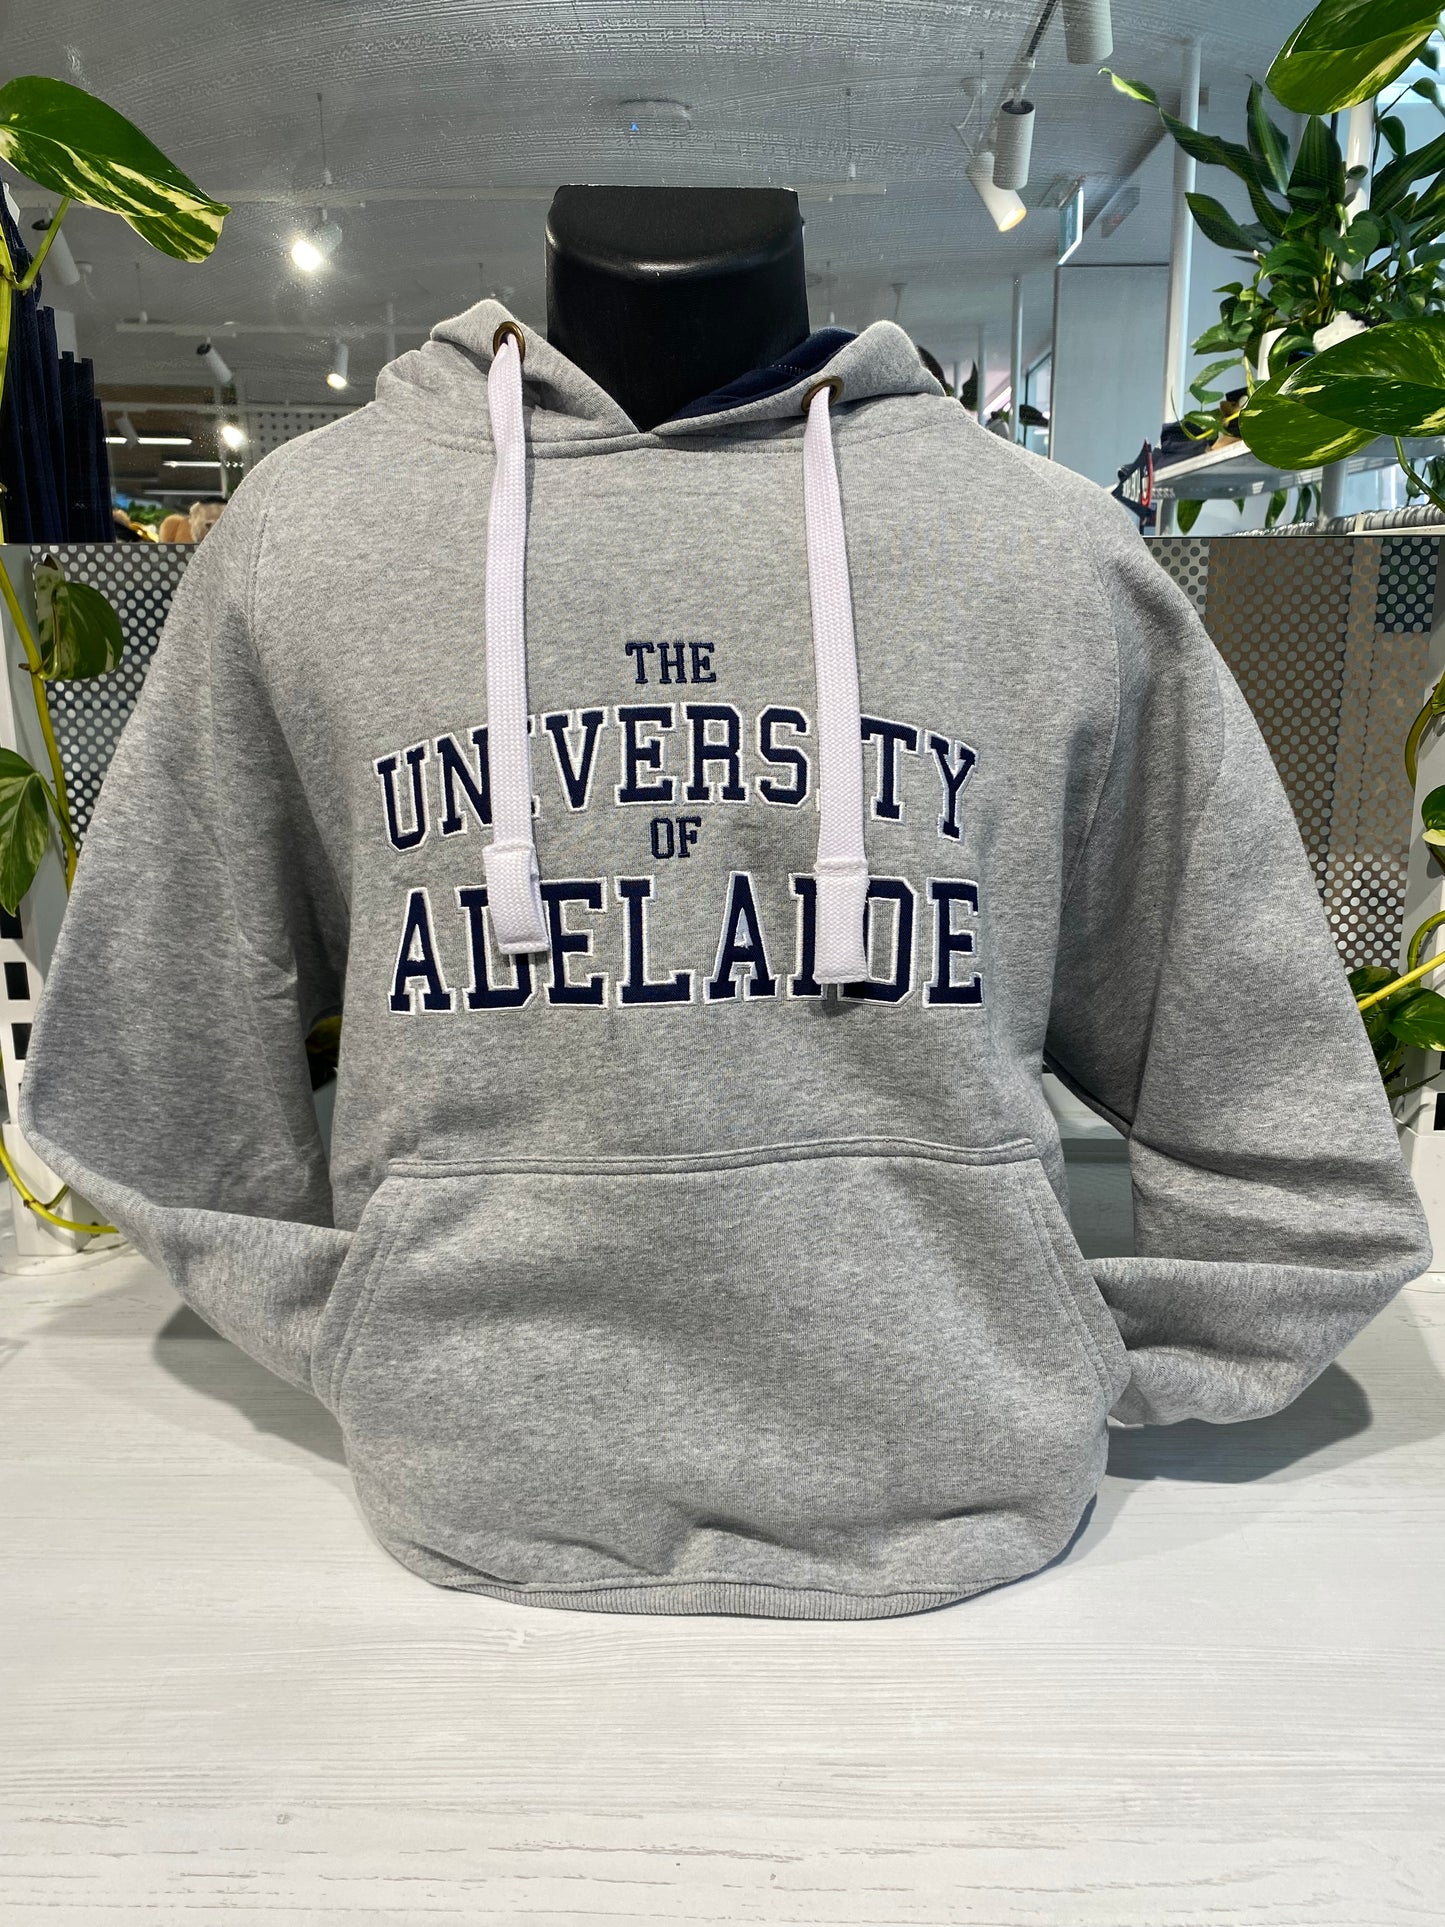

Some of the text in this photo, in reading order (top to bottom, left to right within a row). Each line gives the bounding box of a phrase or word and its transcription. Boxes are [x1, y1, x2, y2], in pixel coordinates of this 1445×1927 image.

[625, 641, 717, 684] THE
[373, 702, 979, 852] UNVERSTY
[650, 815, 701, 859] OF
